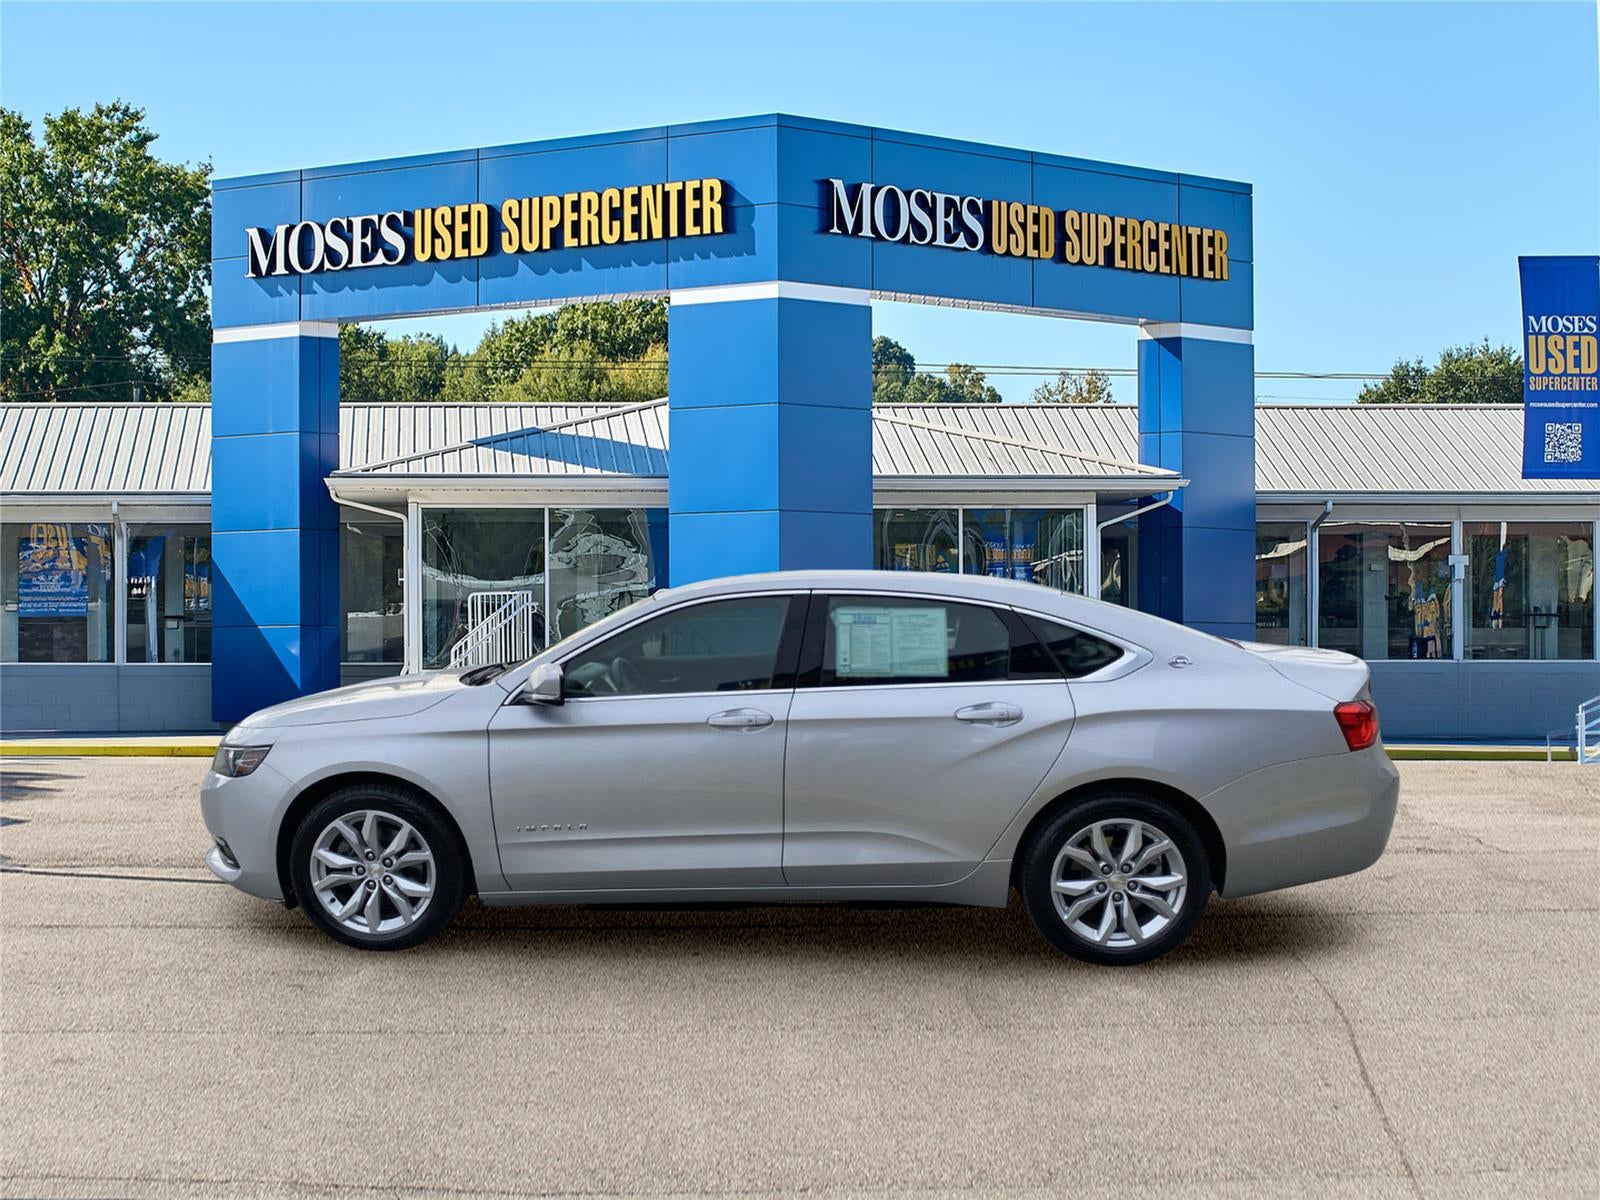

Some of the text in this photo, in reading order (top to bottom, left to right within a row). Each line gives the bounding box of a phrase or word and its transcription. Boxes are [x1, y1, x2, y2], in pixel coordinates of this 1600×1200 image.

[244, 178, 724, 279] MOSES USED SUPERCENTER
[829, 178, 1229, 281] MOSES USED SUPERCENTER
[1528, 315, 1597, 334] MOSES
[1528, 335, 1598, 375] USED
[1529, 376, 1598, 391] SUPERCENTER
